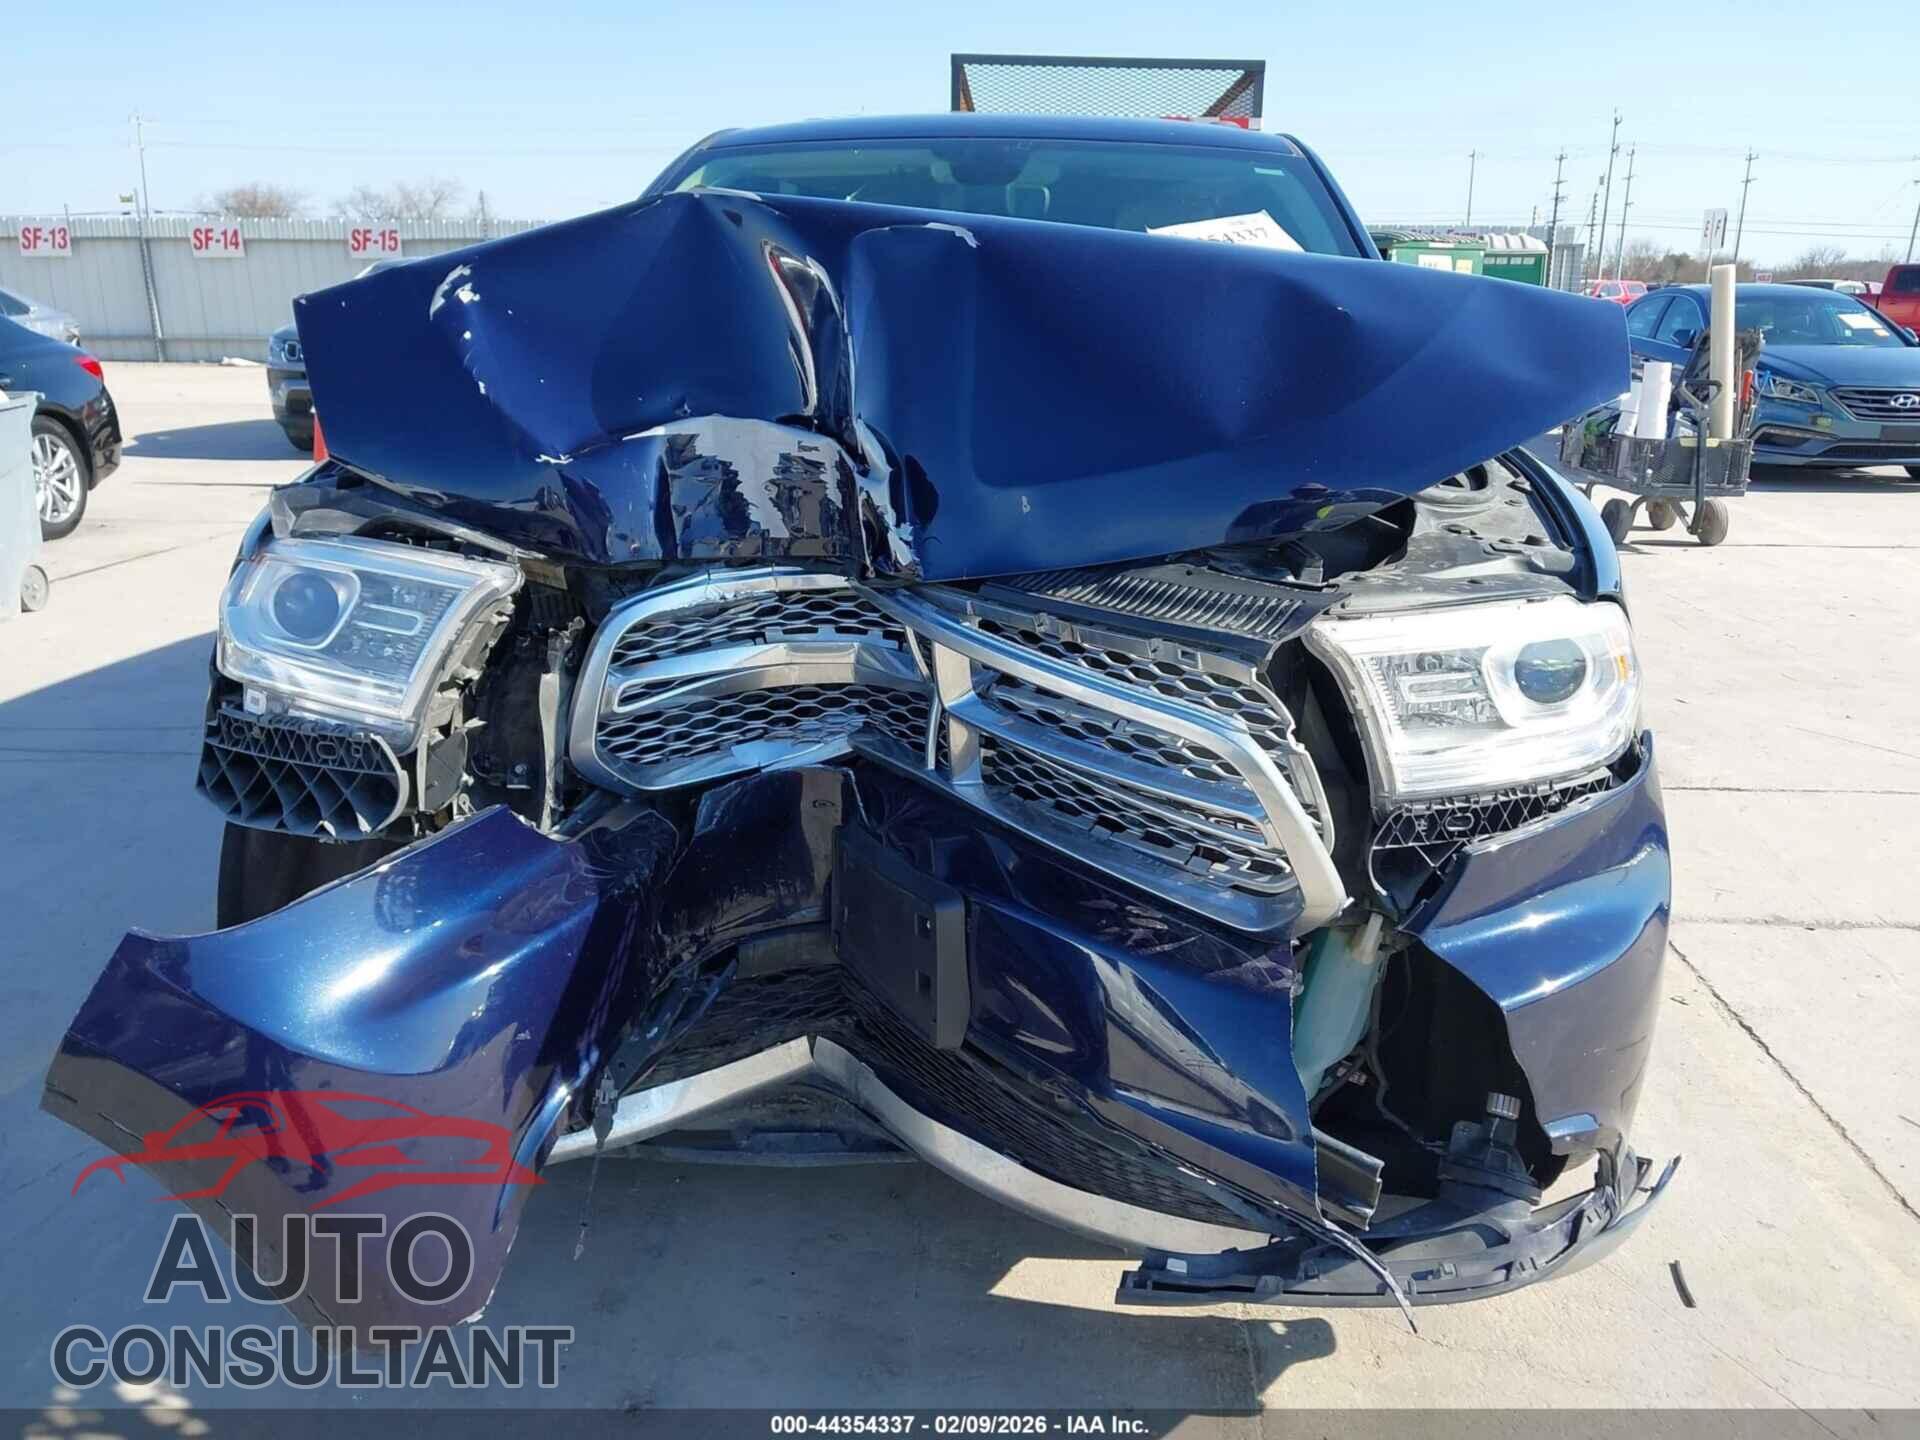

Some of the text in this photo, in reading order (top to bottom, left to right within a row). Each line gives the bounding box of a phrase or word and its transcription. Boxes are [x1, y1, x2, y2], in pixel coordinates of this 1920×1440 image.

[21, 227, 68, 250] SF-13
[192, 227, 241, 251] SF-14
[350, 228, 399, 252] SF-15
